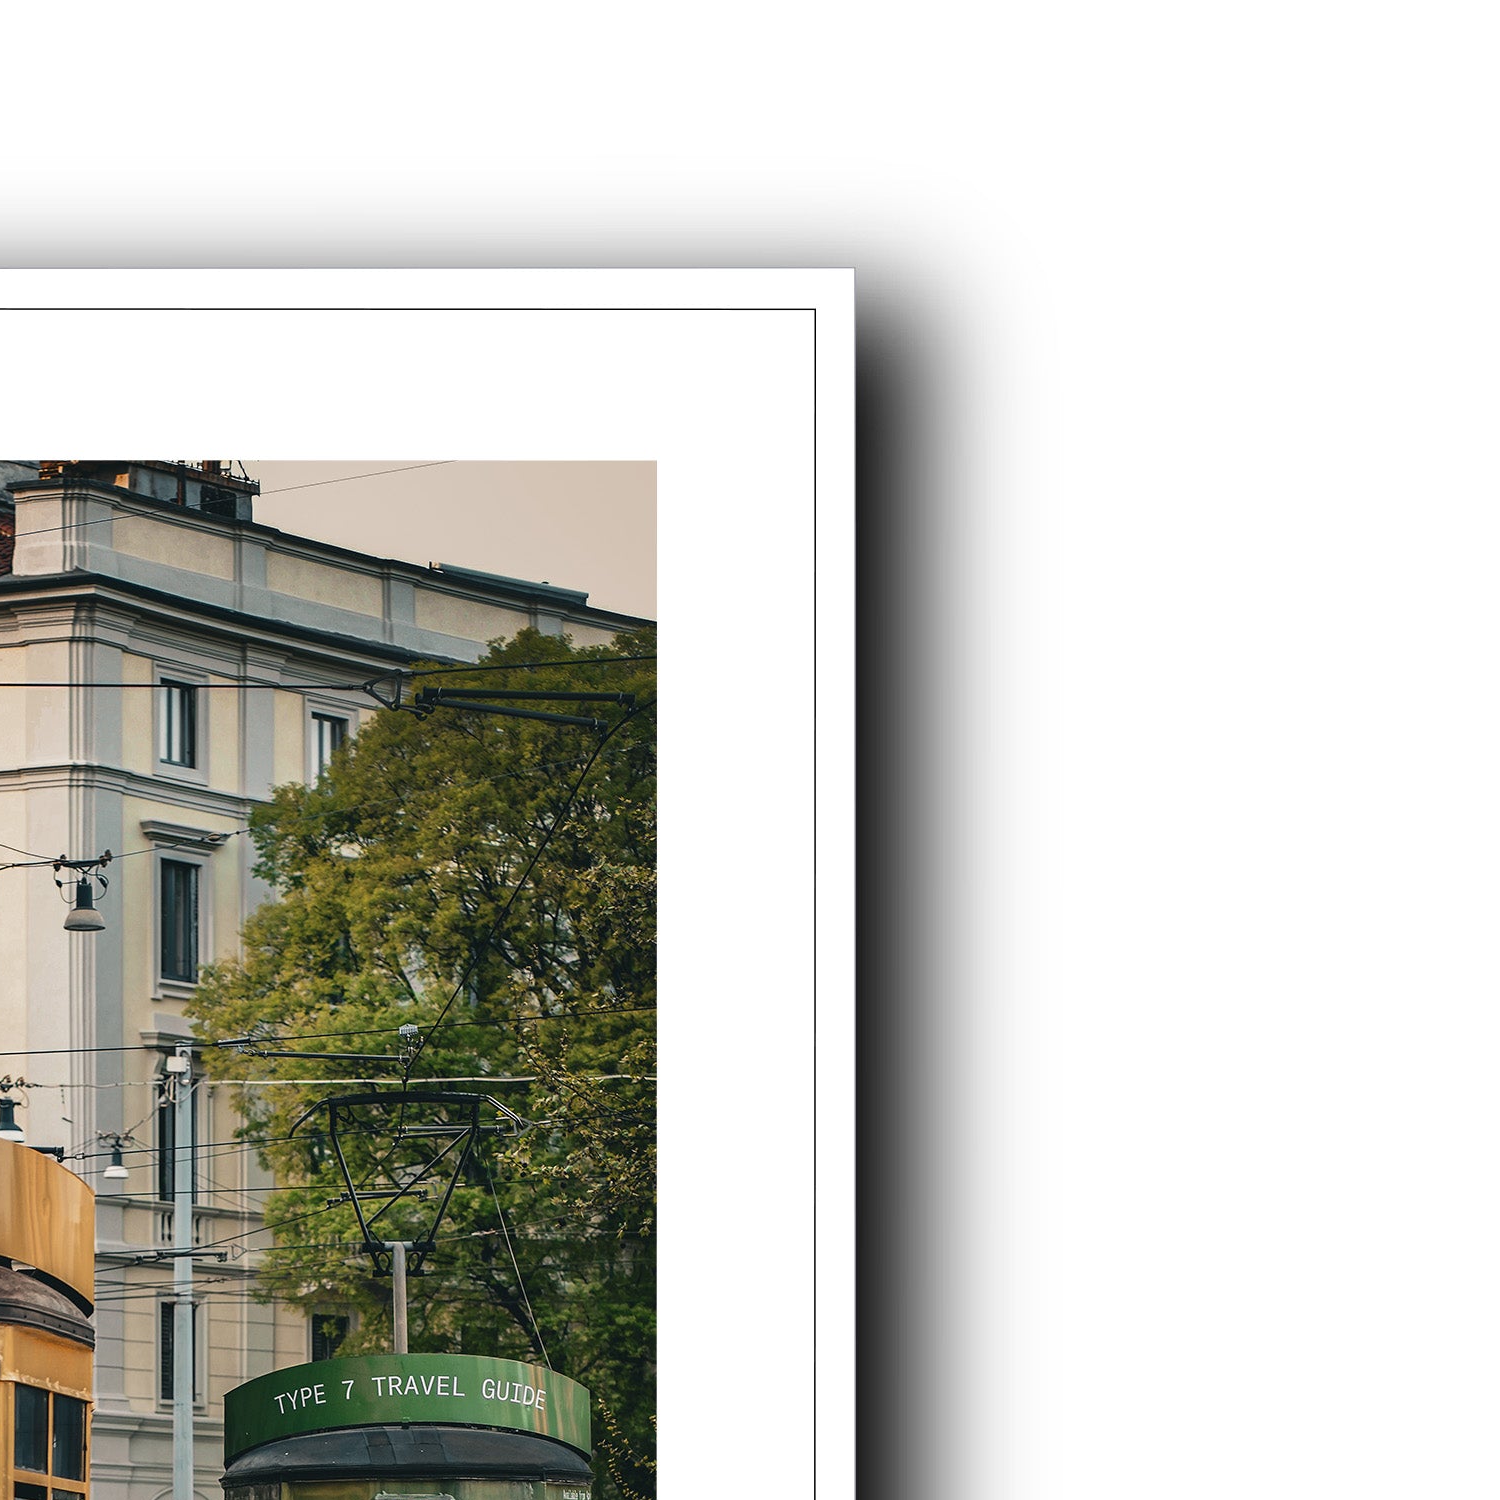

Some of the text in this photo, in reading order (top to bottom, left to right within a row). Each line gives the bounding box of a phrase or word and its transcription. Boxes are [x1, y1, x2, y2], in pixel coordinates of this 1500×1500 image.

[274, 1375, 547, 1414] TYPE 7 TRAVEL GUIDE
